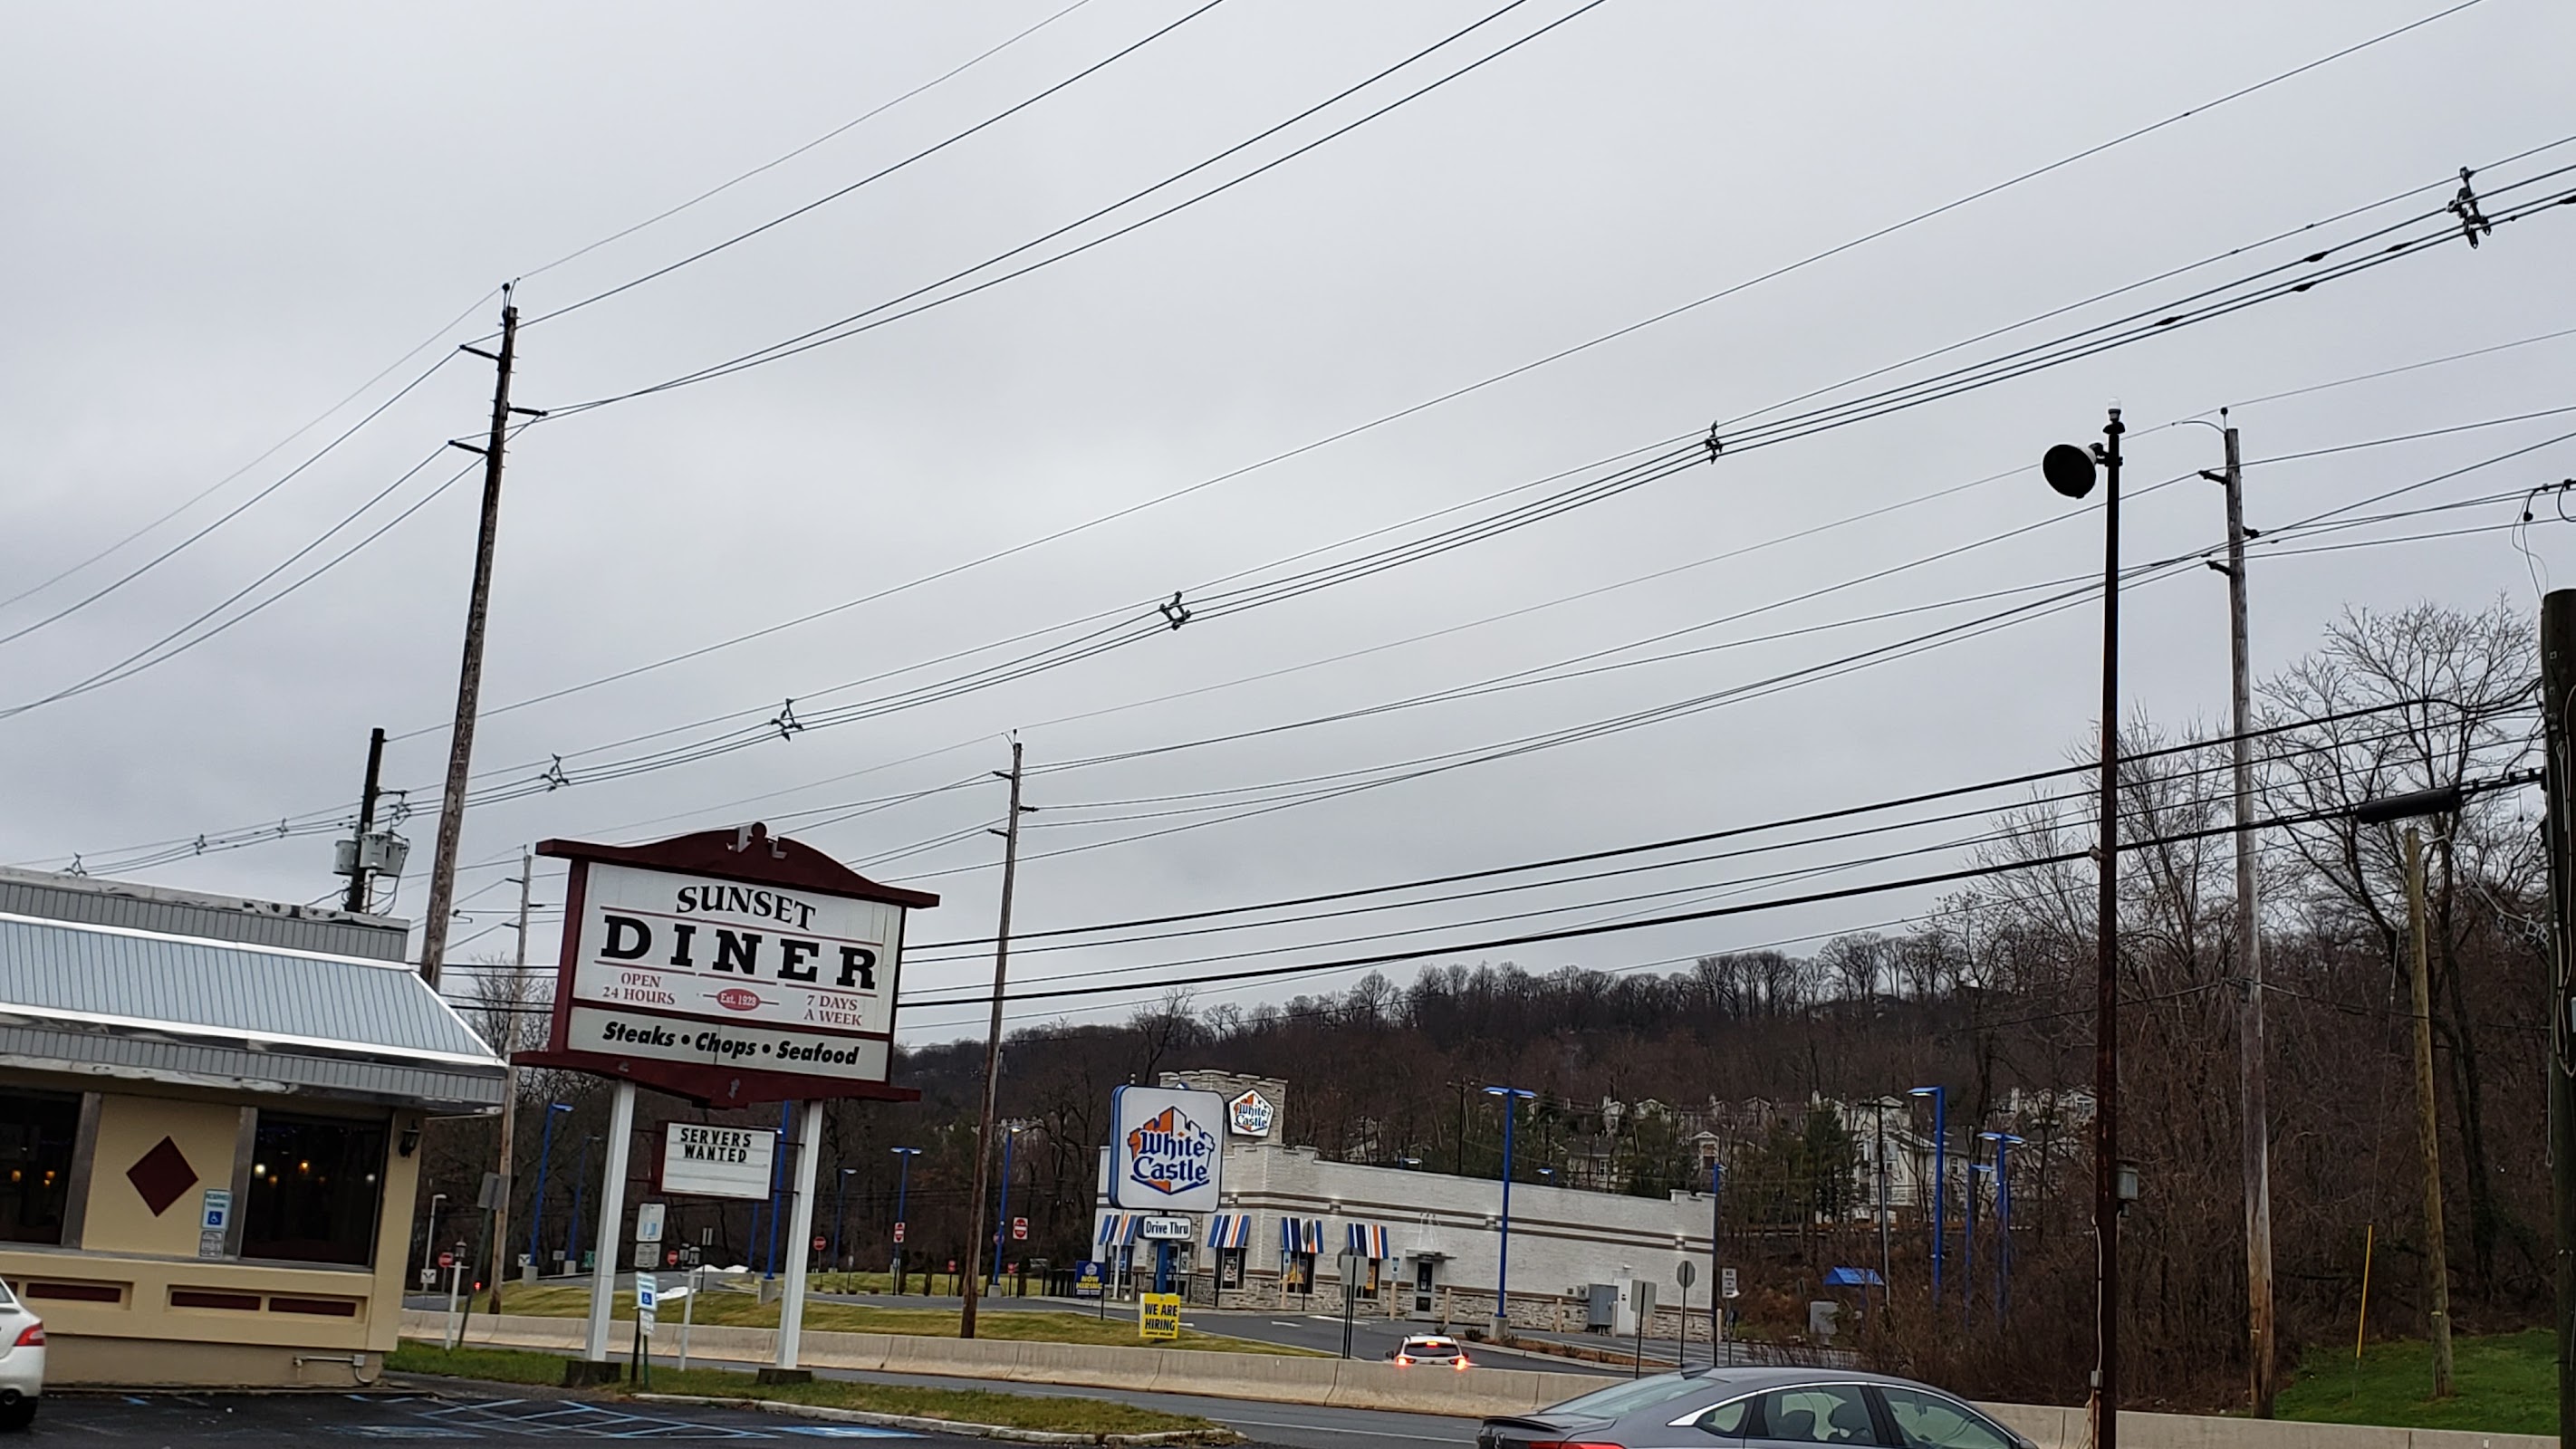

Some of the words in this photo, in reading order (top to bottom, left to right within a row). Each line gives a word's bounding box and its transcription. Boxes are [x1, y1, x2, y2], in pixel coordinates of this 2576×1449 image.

[676, 885, 816, 931] SUNSET
[601, 915, 876, 990] DINER
[620, 972, 661, 988] OPEN
[602, 986, 620, 1000] 24
[623, 988, 676, 1005] HOURS
[720, 993, 735, 1004] Est.
[806, 994, 815, 1006] 7
[819, 996, 859, 1011] DAYS
[804, 1009, 814, 1021] A
[820, 1011, 862, 1026] WEEK
[602, 1022, 676, 1049] Steaks
[695, 1032, 757, 1058] Chops
[776, 1040, 860, 1065] Seafood
[1238, 1103, 1267, 1118] White
[1235, 1114, 1267, 1128] Castle
[680, 1128, 752, 1147] SERVERS
[1139, 1131, 1206, 1160] White
[684, 1144, 747, 1163] WANTED
[1133, 1156, 1207, 1182] Castle
[1146, 1221, 1168, 1234] Drive
[1169, 1221, 1189, 1234] Thru
[1144, 1302, 1158, 1315] WE
[1160, 1304, 1178, 1317] ARE
[1144, 1318, 1176, 1331] HIRING
